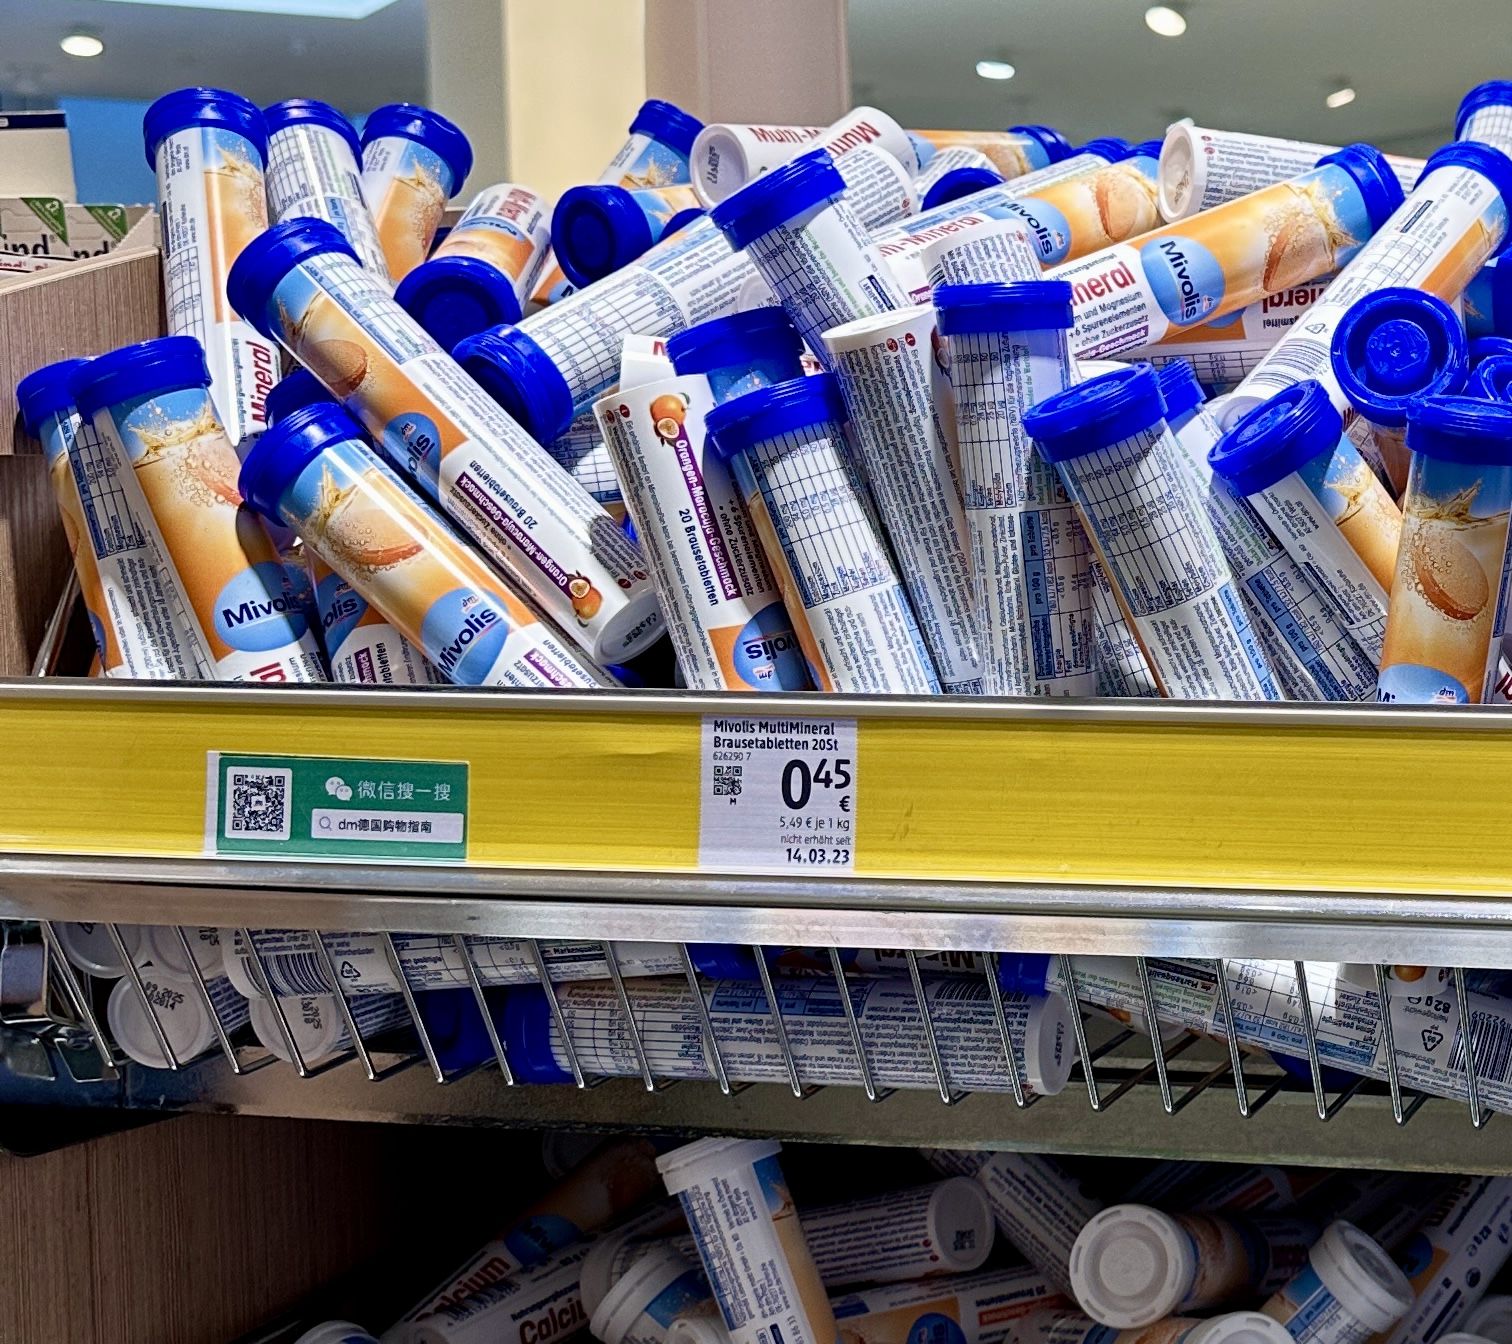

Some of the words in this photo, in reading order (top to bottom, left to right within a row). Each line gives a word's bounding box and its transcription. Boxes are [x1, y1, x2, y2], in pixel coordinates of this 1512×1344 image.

[1001, 201, 1053, 257] Mivolis
[1159, 240, 1197, 320] Mivolis
[470, 459, 527, 522] Brausetabletten
[524, 512, 539, 530] 20
[676, 440, 738, 597] Orangen-Maracuja-Geschmack
[721, 513, 733, 536] ohne
[460, 475, 568, 587] Orangen-Maracuja-Geschmack
[679, 508, 690, 522] 20
[685, 521, 719, 606] Brausetabletten
[223, 587, 301, 629] Mivolis
[437, 607, 498, 677] Mivolis
[713, 720, 756, 734] Mivolis
[758, 721, 835, 736] MultiMineral
[713, 736, 809, 751] Brausetabletten
[811, 738, 839, 752] 20St
[746, 752, 752, 761] 7
[357, 779, 452, 802] 微信搜一搜
[839, 795, 851, 813] €
[338, 818, 433, 834] dm德国购物指南
[779, 816, 803, 830] 5,49
[806, 817, 813, 829] €
[814, 817, 826, 832] je
[828, 818, 833, 829] 1
[837, 817, 850, 832] kg
[780, 834, 802, 844] nicht
[804, 835, 834, 845] erhöht
[836, 836, 852, 846] seit
[786, 848, 850, 865] 14.03.23
